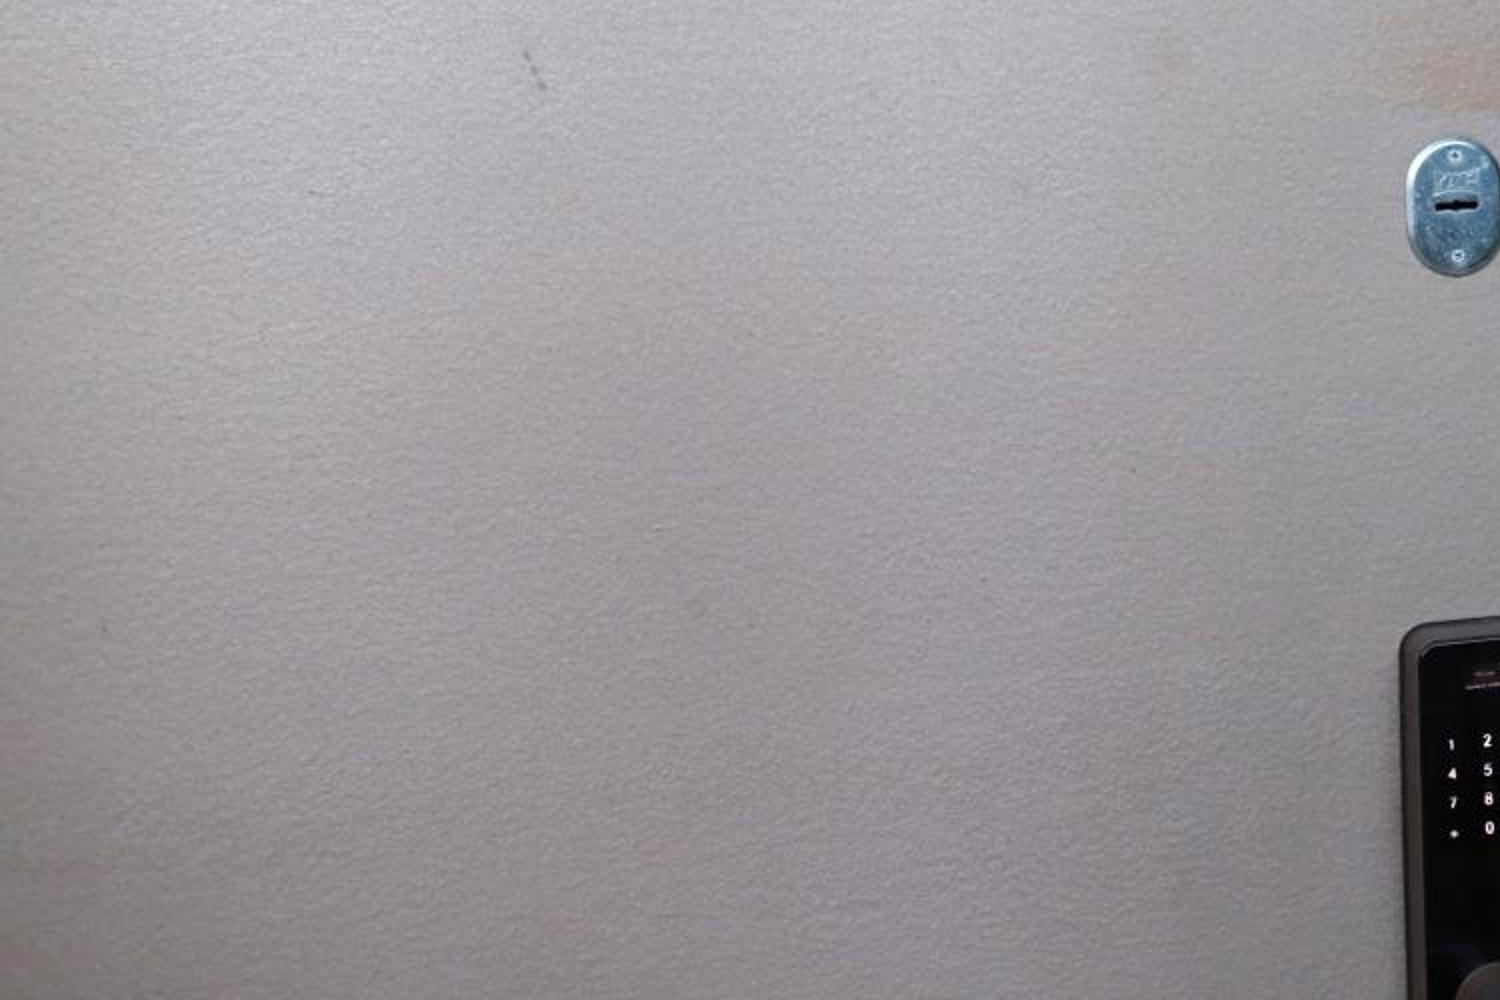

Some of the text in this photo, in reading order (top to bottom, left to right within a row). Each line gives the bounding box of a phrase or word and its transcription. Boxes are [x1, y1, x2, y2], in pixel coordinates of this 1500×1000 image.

[1448, 738, 1455, 751] 1
[1482, 733, 1493, 748] 2
[1447, 767, 1458, 780] 4
[1483, 763, 1493, 777] 5
[1449, 796, 1458, 809] 7
[1484, 791, 1494, 806] 8
[1484, 820, 1495, 835] 0
